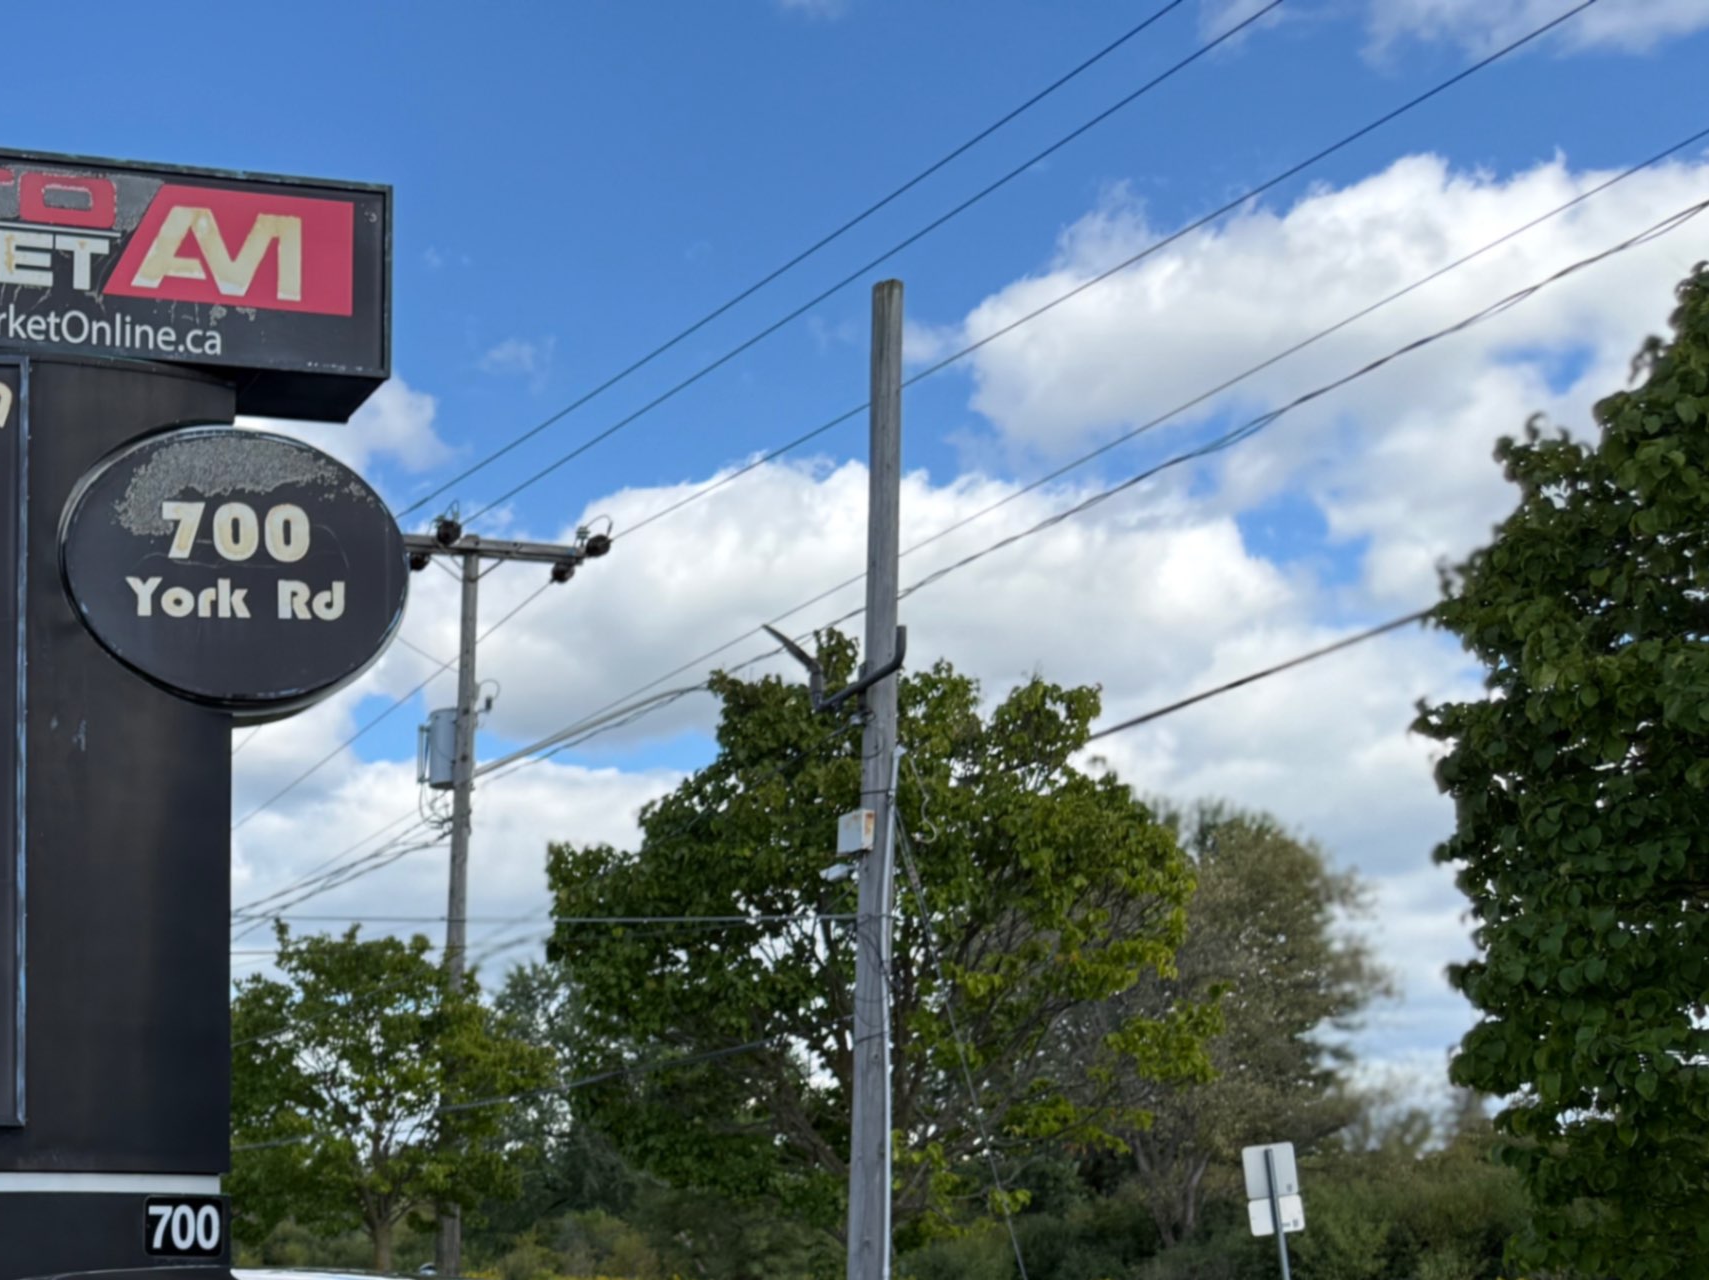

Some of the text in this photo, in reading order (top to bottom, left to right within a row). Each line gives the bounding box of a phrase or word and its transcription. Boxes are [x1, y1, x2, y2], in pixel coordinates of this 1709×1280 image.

[161, 500, 311, 563] 700
[125, 576, 346, 621] York Rd
[148, 1204, 220, 1251] 700
